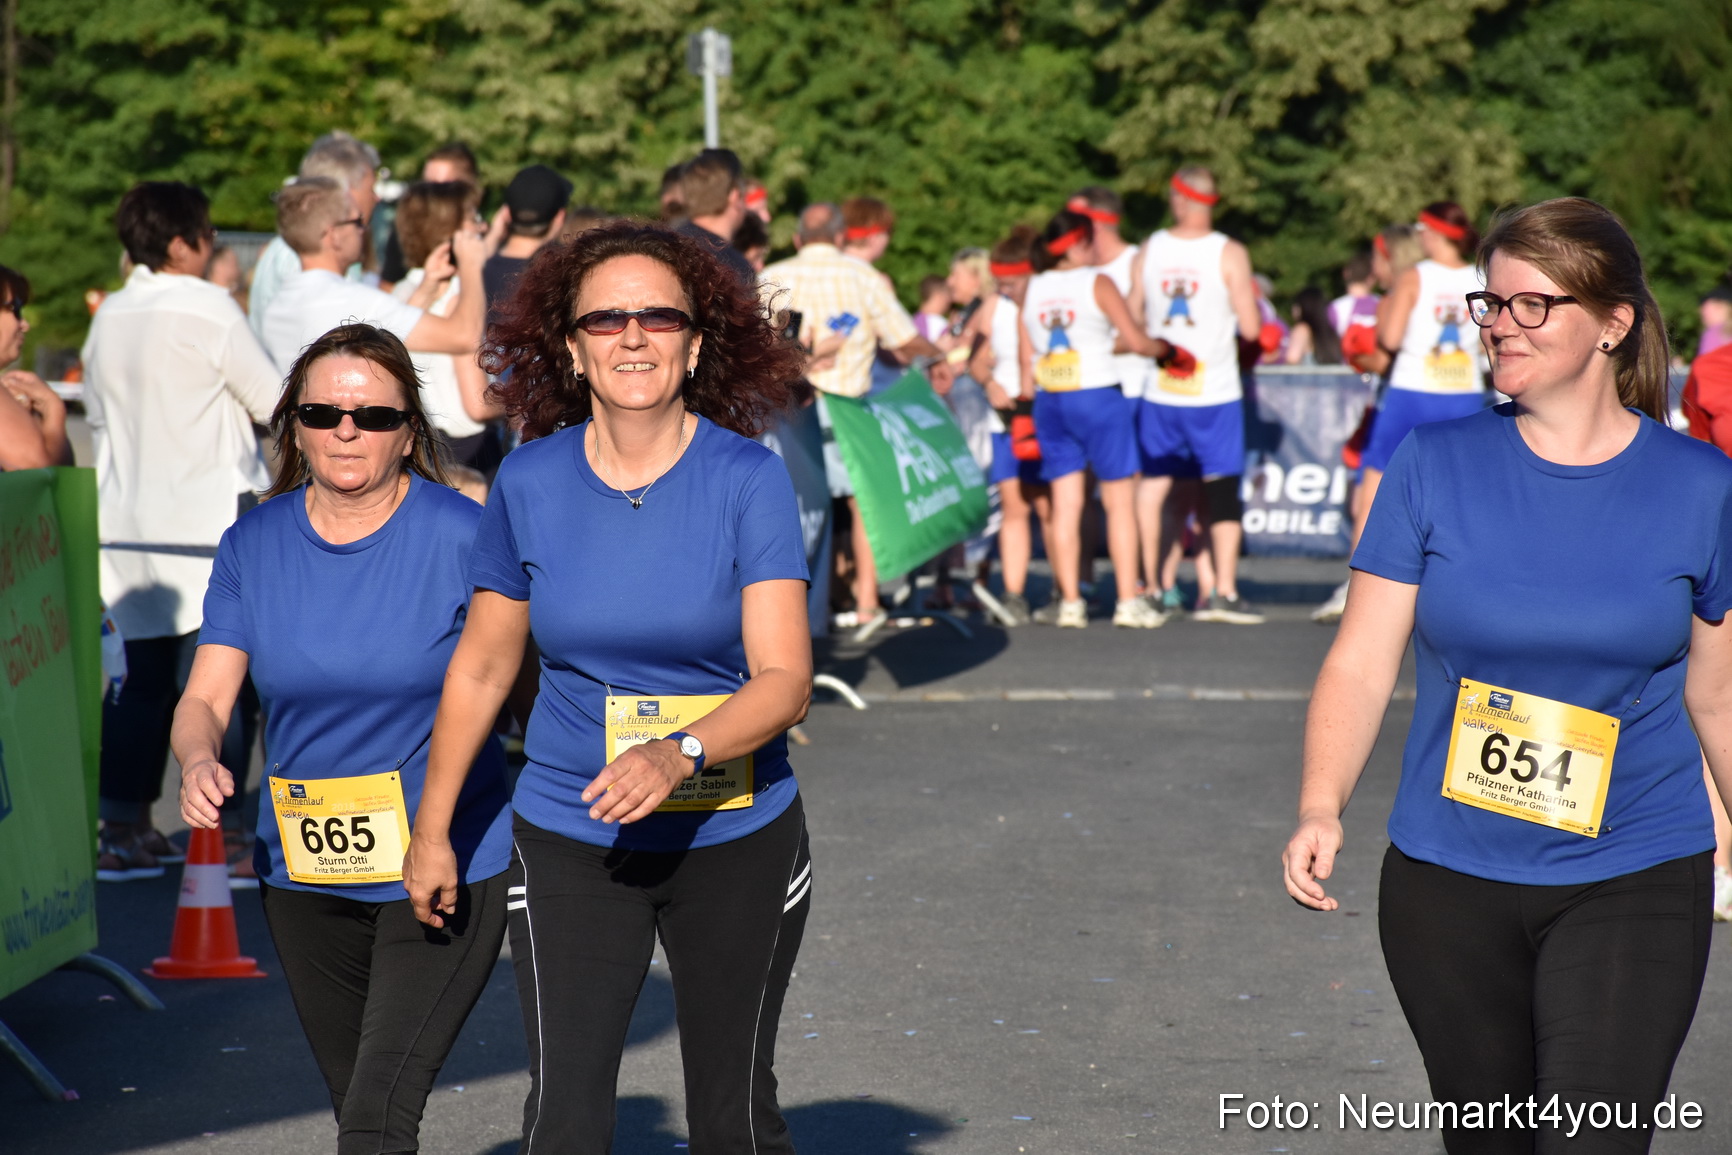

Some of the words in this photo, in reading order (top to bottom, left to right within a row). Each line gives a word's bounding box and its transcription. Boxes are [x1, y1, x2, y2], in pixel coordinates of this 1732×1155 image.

[1242, 508, 1342, 535] OBILE
[627, 714, 680, 724] firmenlauf
[1475, 702, 1533, 725] firmenlauf
[1462, 717, 1503, 734] walken
[615, 729, 658, 741] walken
[1480, 732, 1573, 792] 654
[676, 782, 698, 791] zer
[700, 779, 737, 790] Sabine
[1466, 771, 1515, 794] Pfälzner
[1517, 783, 1577, 810] Katharina
[284, 796, 325, 806] firmenlauf
[669, 793, 695, 801] Berger
[697, 792, 721, 800] GmbH
[1480, 789, 1498, 800] Fritz
[1500, 794, 1527, 808] Berger
[1529, 801, 1556, 815] GmbH
[331, 802, 355, 813] 2018
[300, 815, 376, 855] 665
[317, 855, 348, 866] Sturm
[349, 855, 368, 865] Otti
[330, 867, 353, 875] Berger
